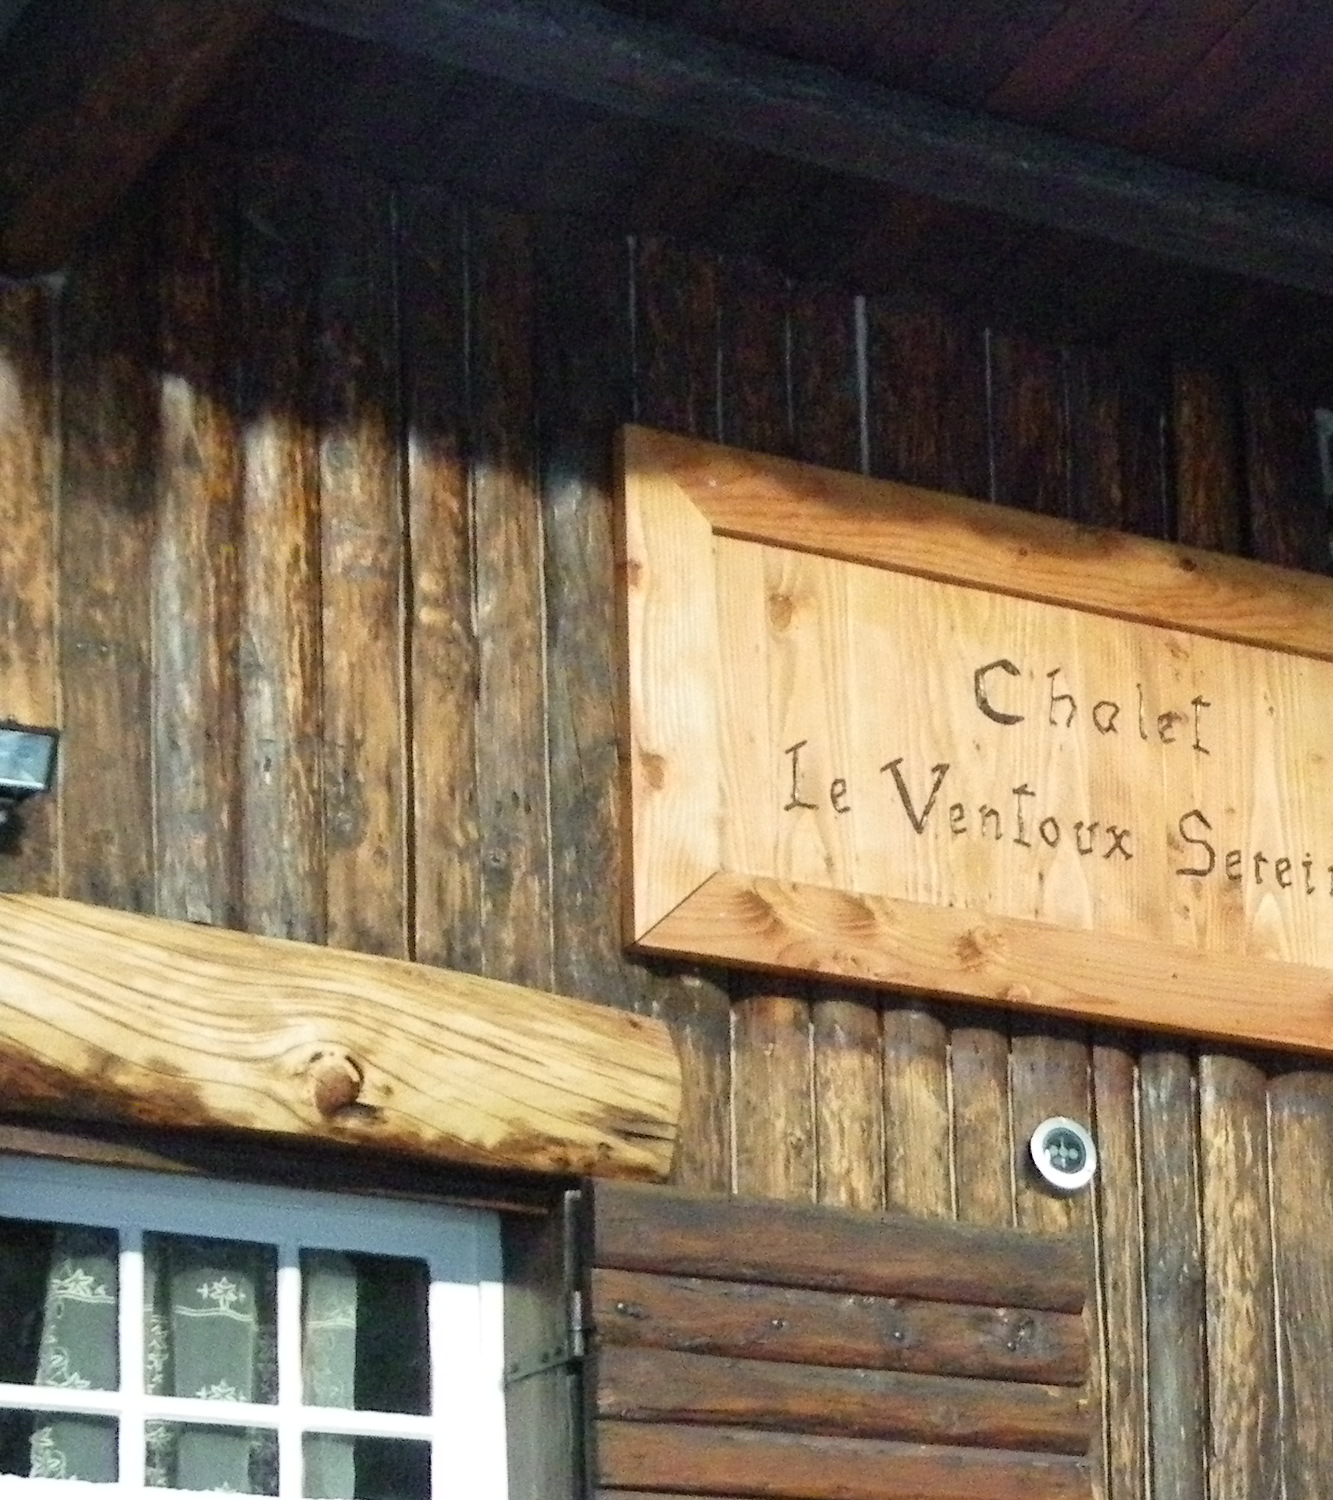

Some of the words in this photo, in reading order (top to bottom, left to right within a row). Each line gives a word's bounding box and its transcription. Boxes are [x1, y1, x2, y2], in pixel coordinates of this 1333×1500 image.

[973, 658, 1212, 755] Chalet
[784, 740, 851, 814] Le
[880, 757, 1134, 862] Ventoux
